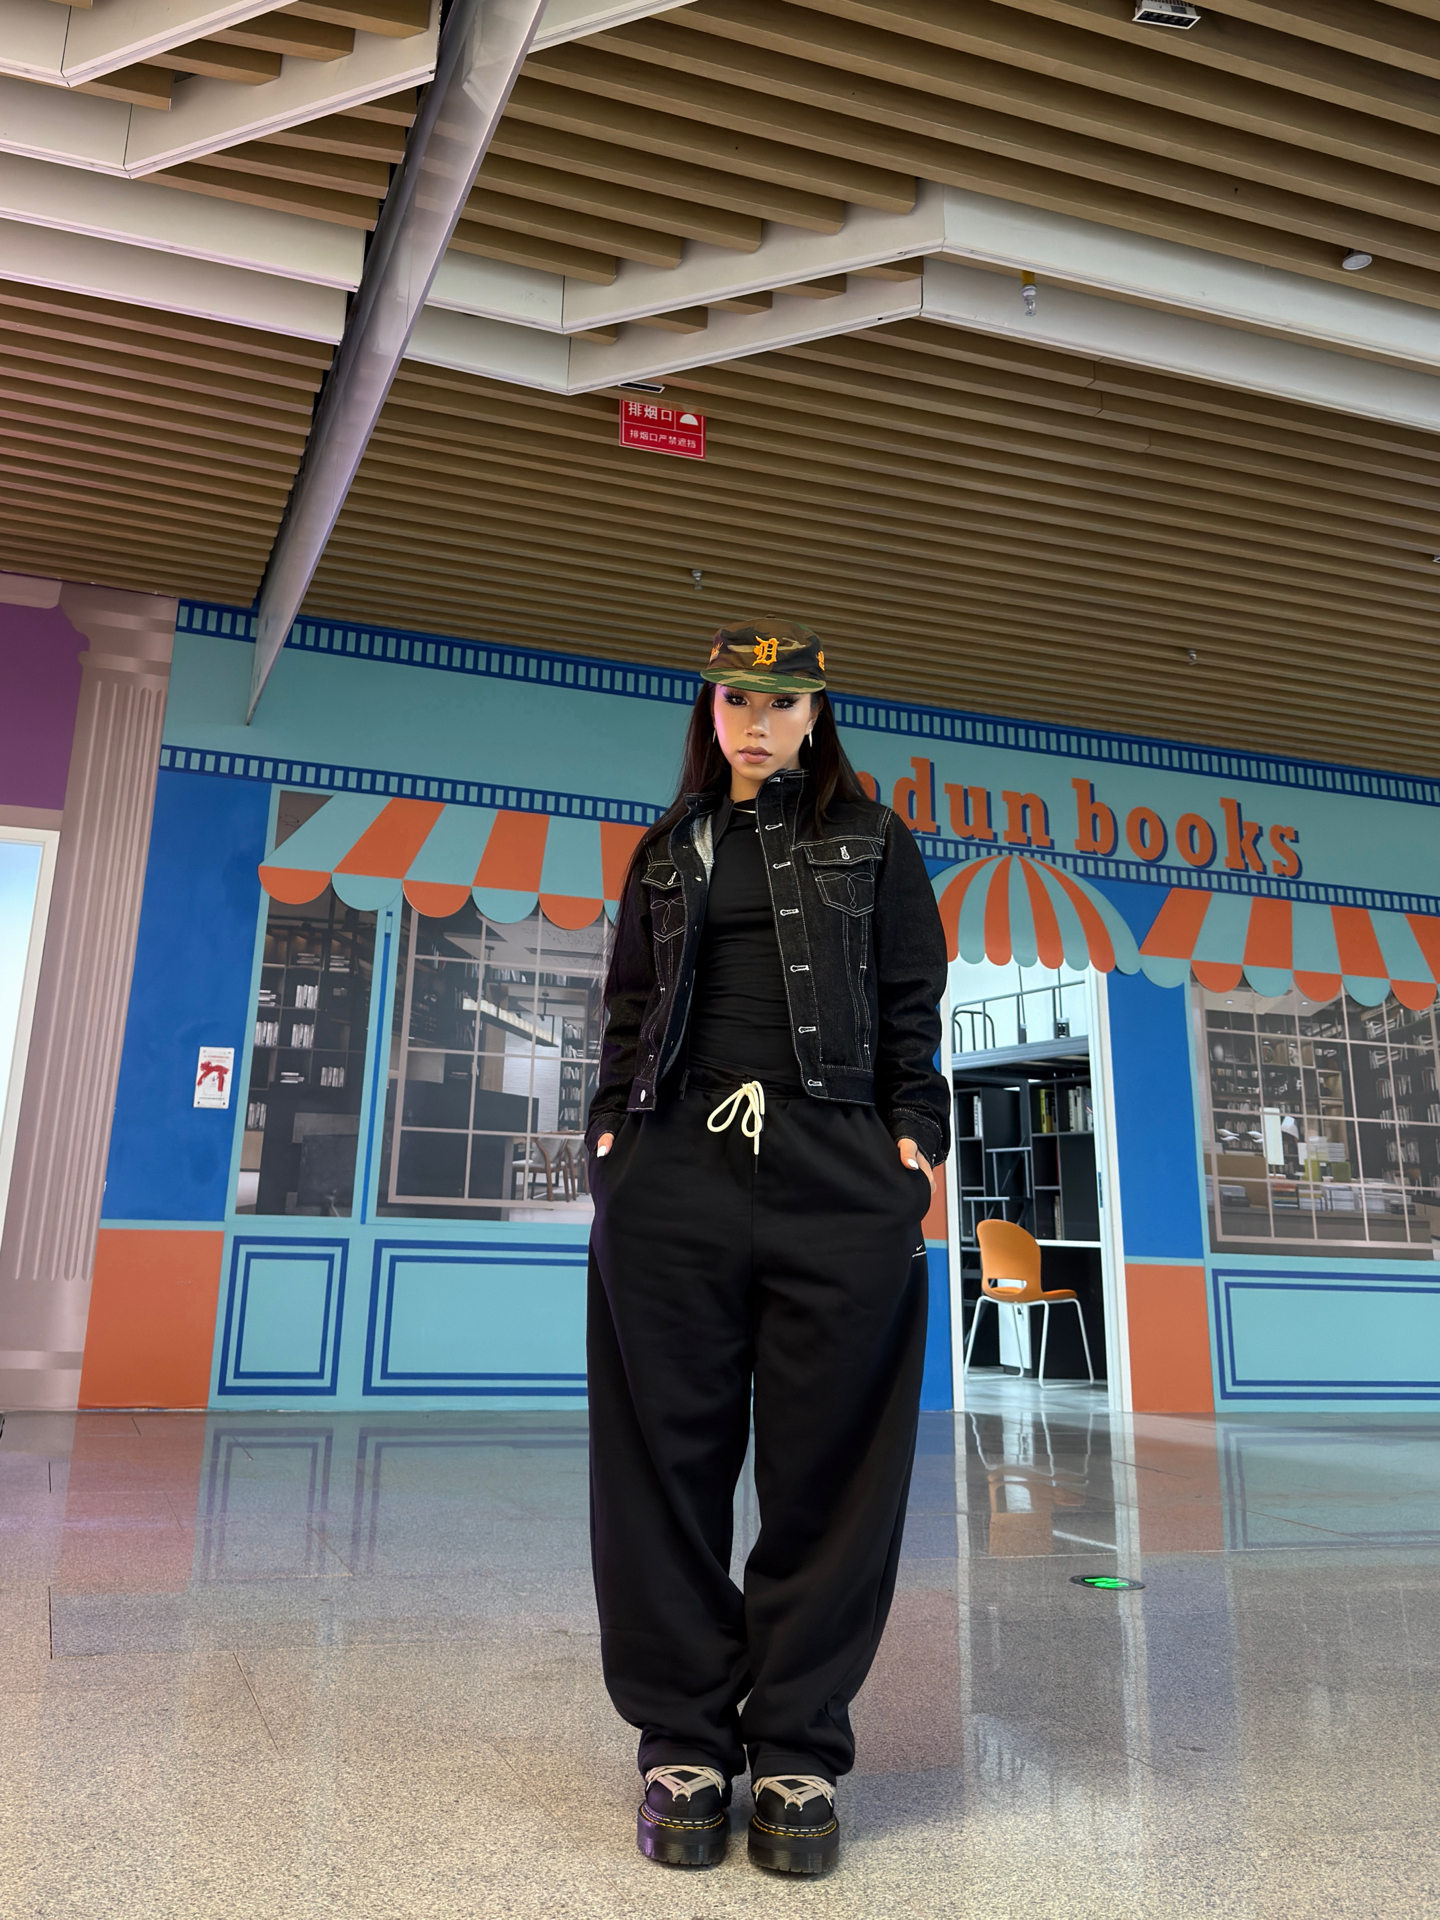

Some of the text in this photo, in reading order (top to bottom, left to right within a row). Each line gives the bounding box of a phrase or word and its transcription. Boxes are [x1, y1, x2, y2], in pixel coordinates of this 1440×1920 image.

[628, 402, 672, 421] 排烟口
[629, 429, 696, 449] 排烟口严禁遮挡
[752, 636, 780, 666] D
[1071, 778, 1302, 879] books
